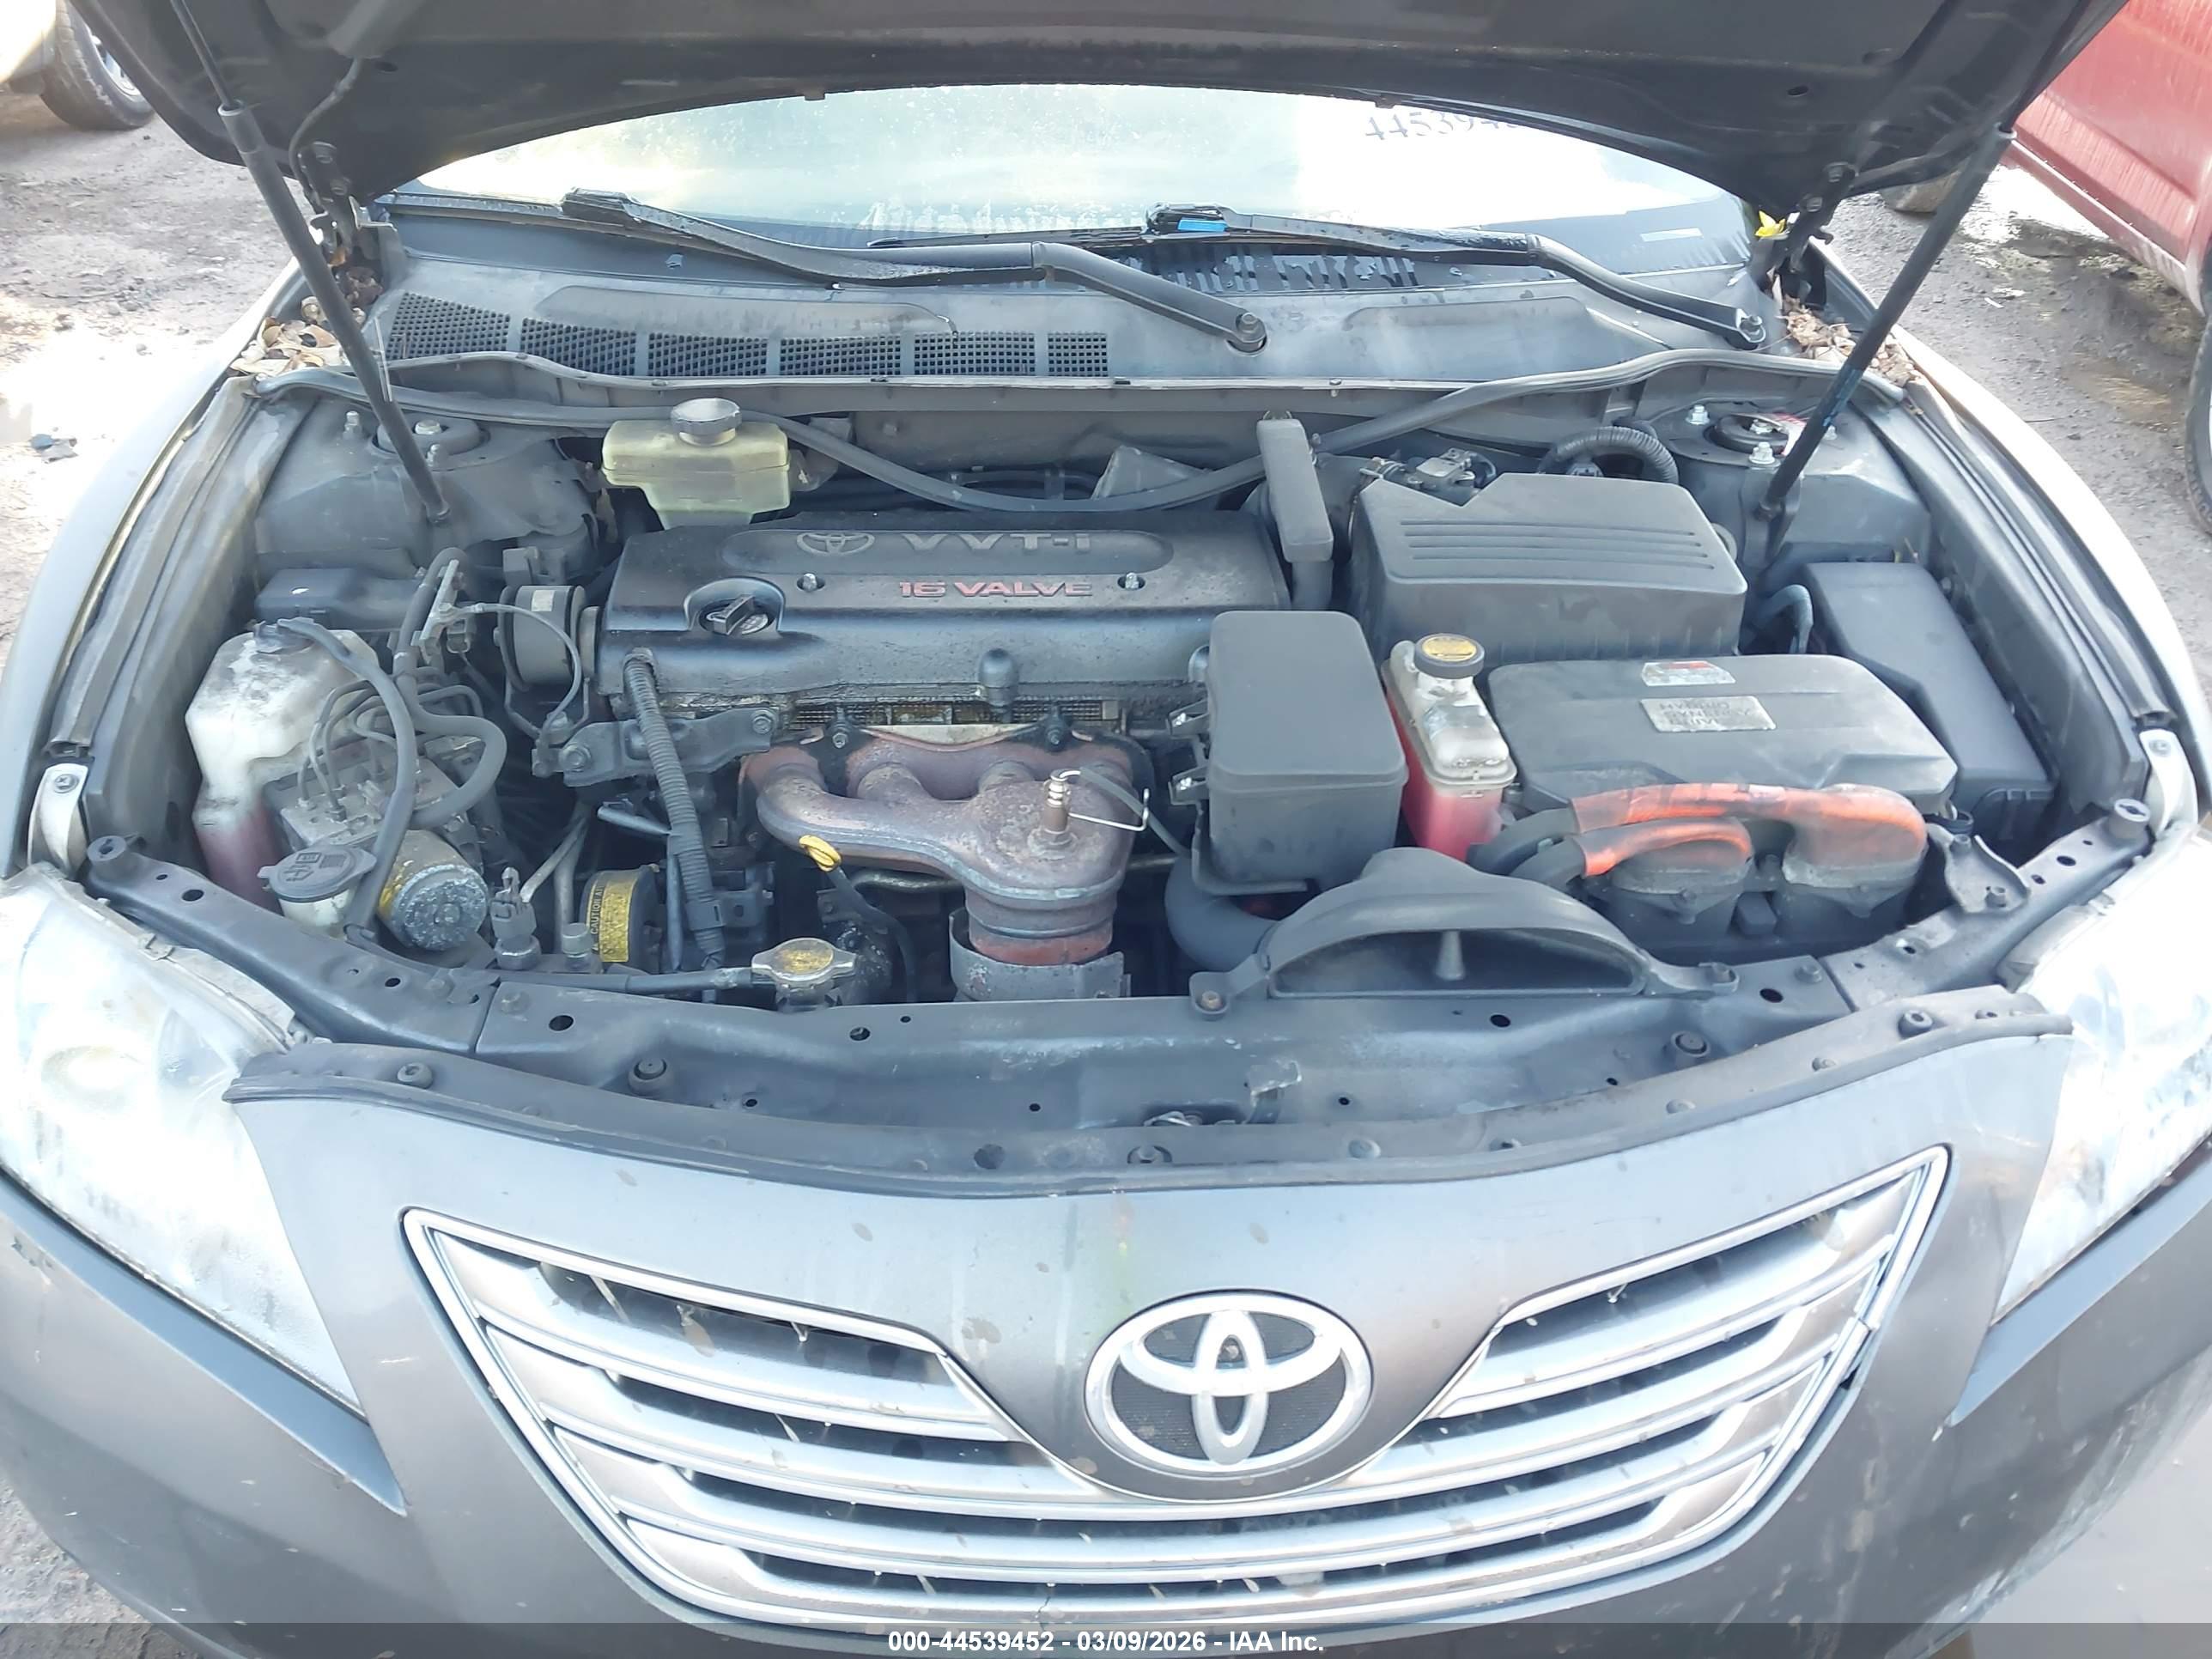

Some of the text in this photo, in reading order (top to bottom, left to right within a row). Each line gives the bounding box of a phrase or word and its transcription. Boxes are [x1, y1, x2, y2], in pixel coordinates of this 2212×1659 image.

[901, 532, 1091, 550] VVT-i
[899, 581, 1093, 598] 16 VALVE
[590, 898, 602, 935] CAUTION
